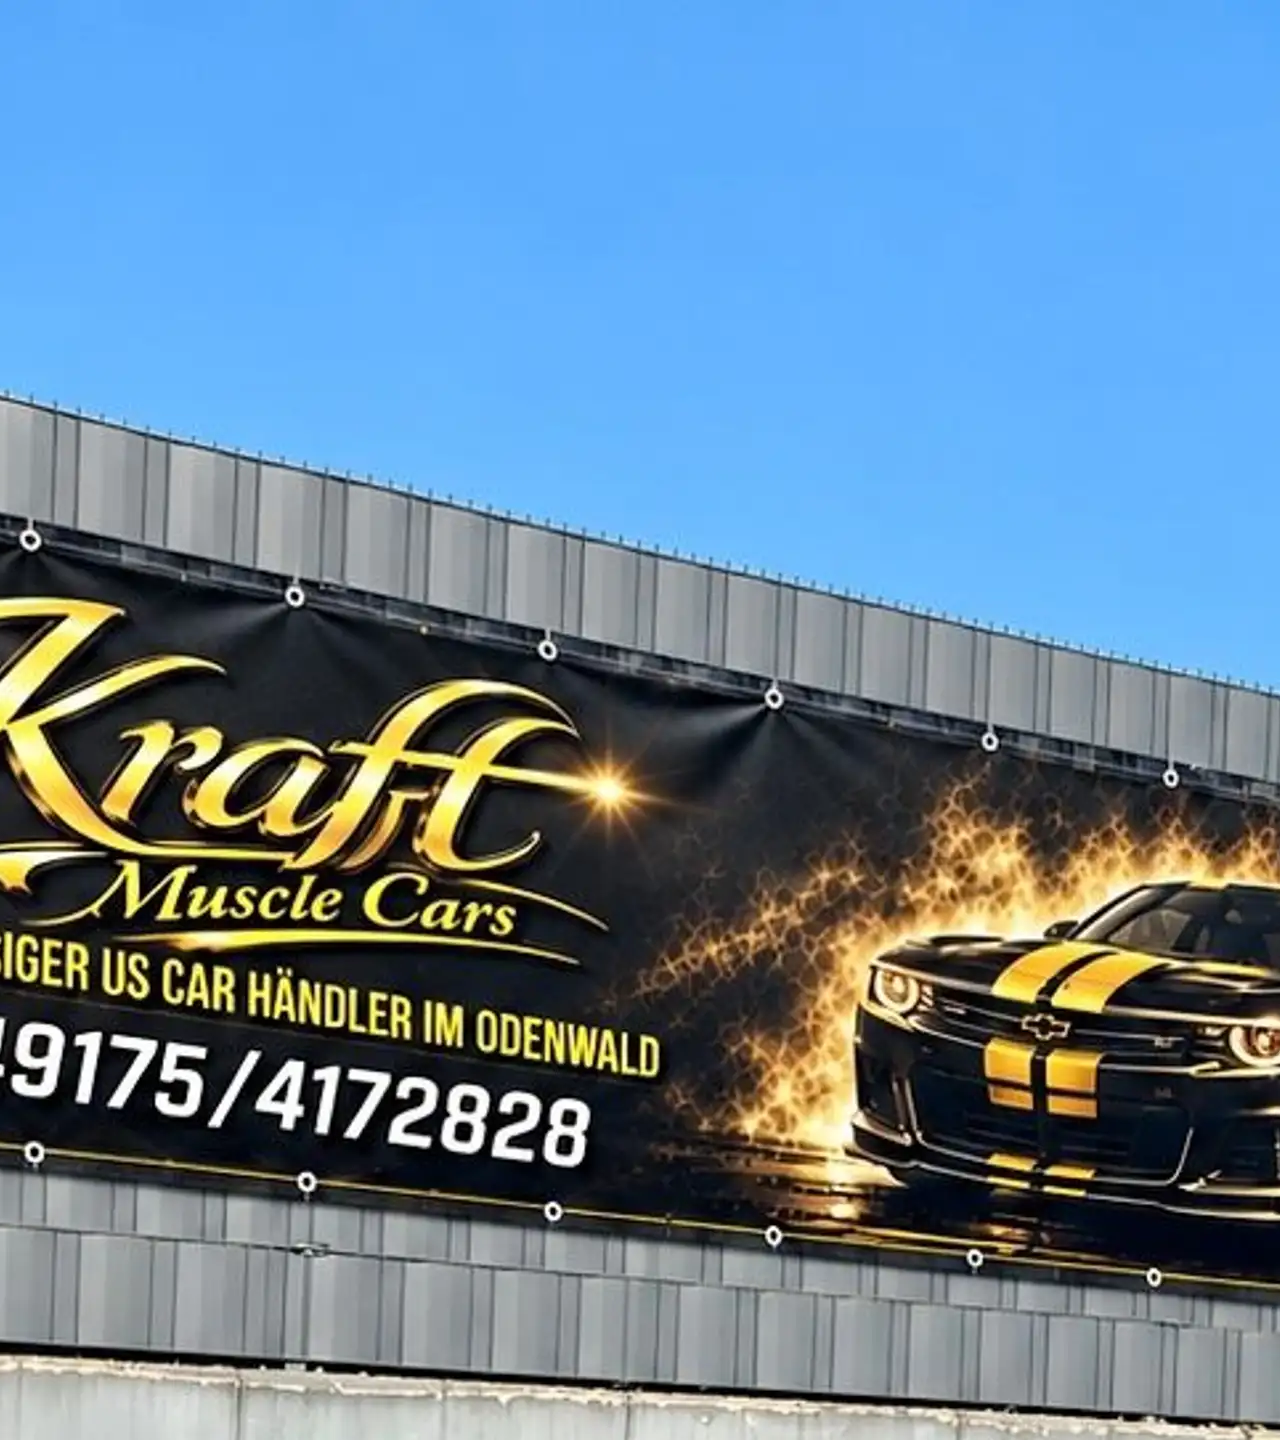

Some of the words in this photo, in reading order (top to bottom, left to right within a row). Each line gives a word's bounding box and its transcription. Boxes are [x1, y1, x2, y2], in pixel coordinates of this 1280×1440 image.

[92, 858, 343, 924] Muscle
[362, 872, 518, 936] Cars
[101, 947, 152, 1001] US
[161, 957, 235, 1013] CAR
[247, 967, 412, 1041] HÄNDLER
[423, 999, 465, 1050] IM
[476, 1009, 661, 1078] ODENWALD
